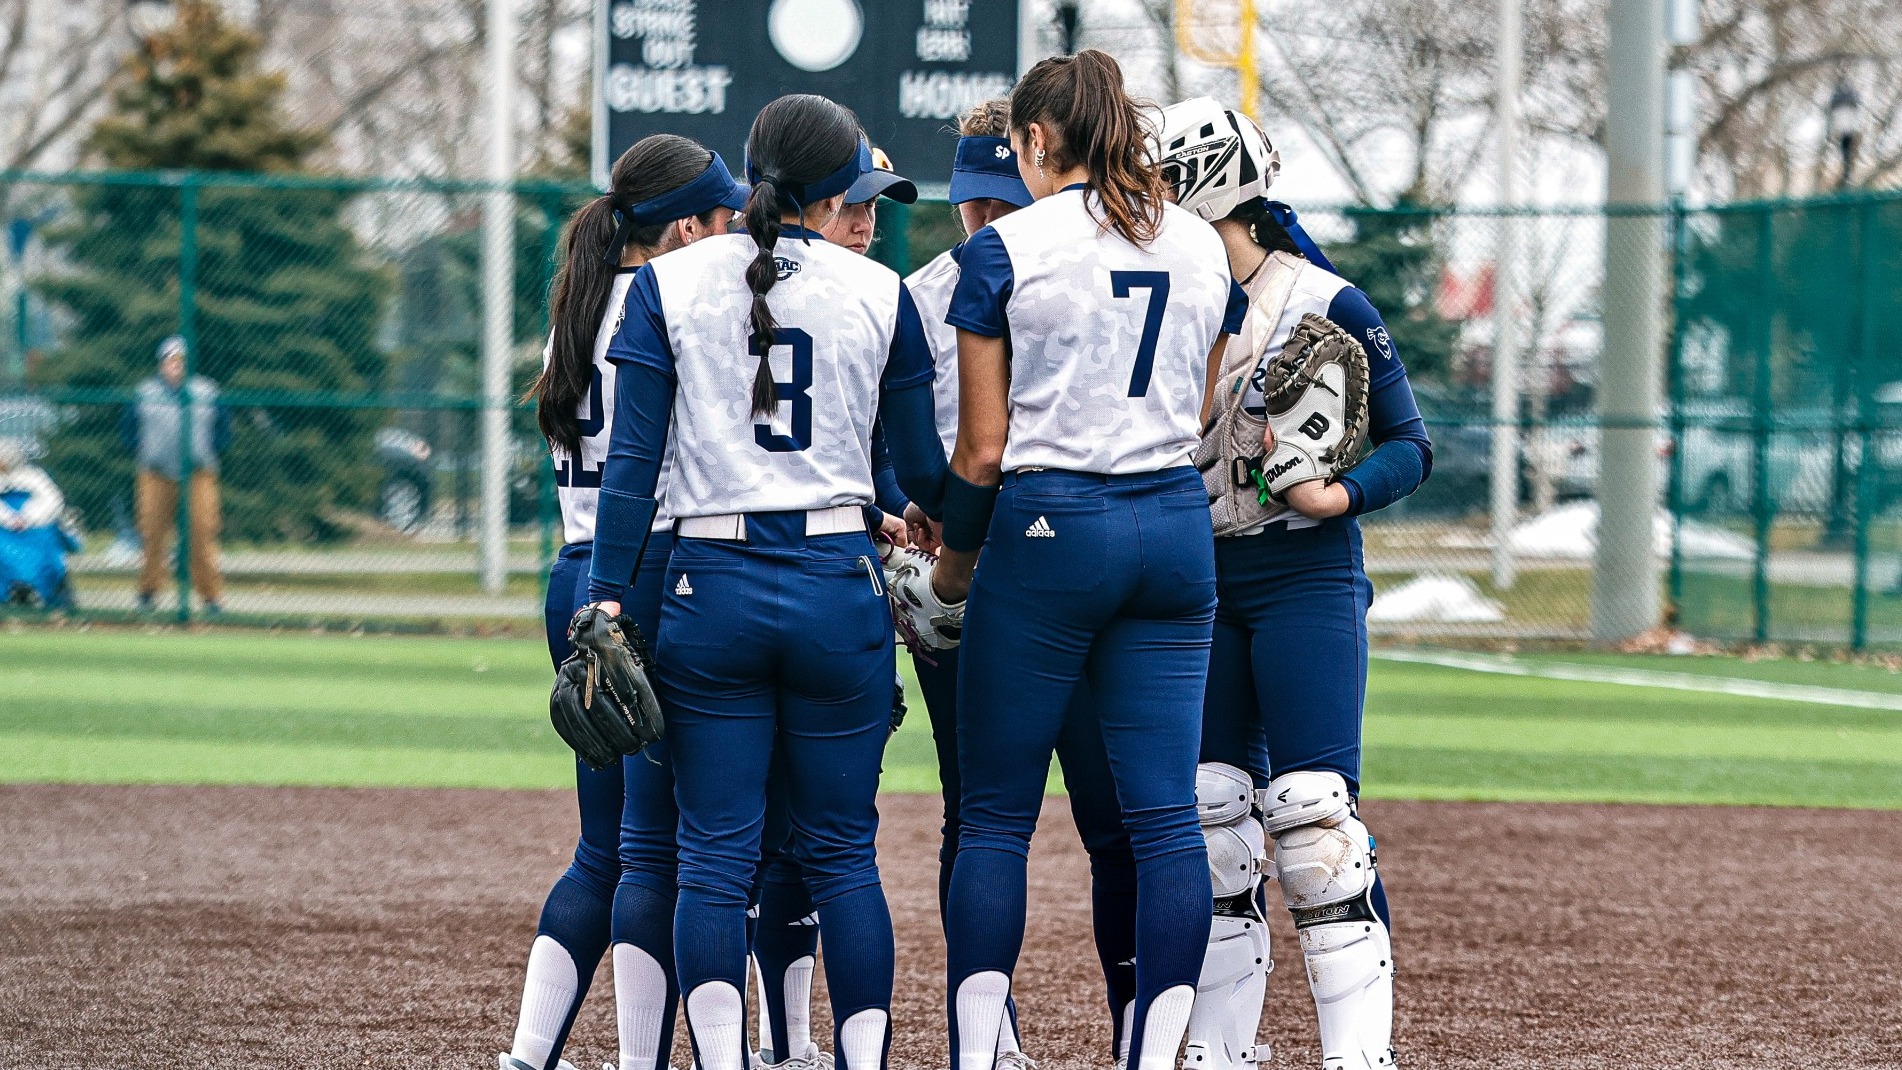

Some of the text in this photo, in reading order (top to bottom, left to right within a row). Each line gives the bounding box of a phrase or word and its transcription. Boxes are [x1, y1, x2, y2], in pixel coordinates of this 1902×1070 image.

[607, 63, 732, 115] GUEST
[1176, 145, 1210, 160] EASTON
[1110, 270, 1170, 398] 7
[748, 327, 813, 453] 3
[1264, 456, 1301, 484] Wilson
[1025, 528, 1056, 538] adidas
